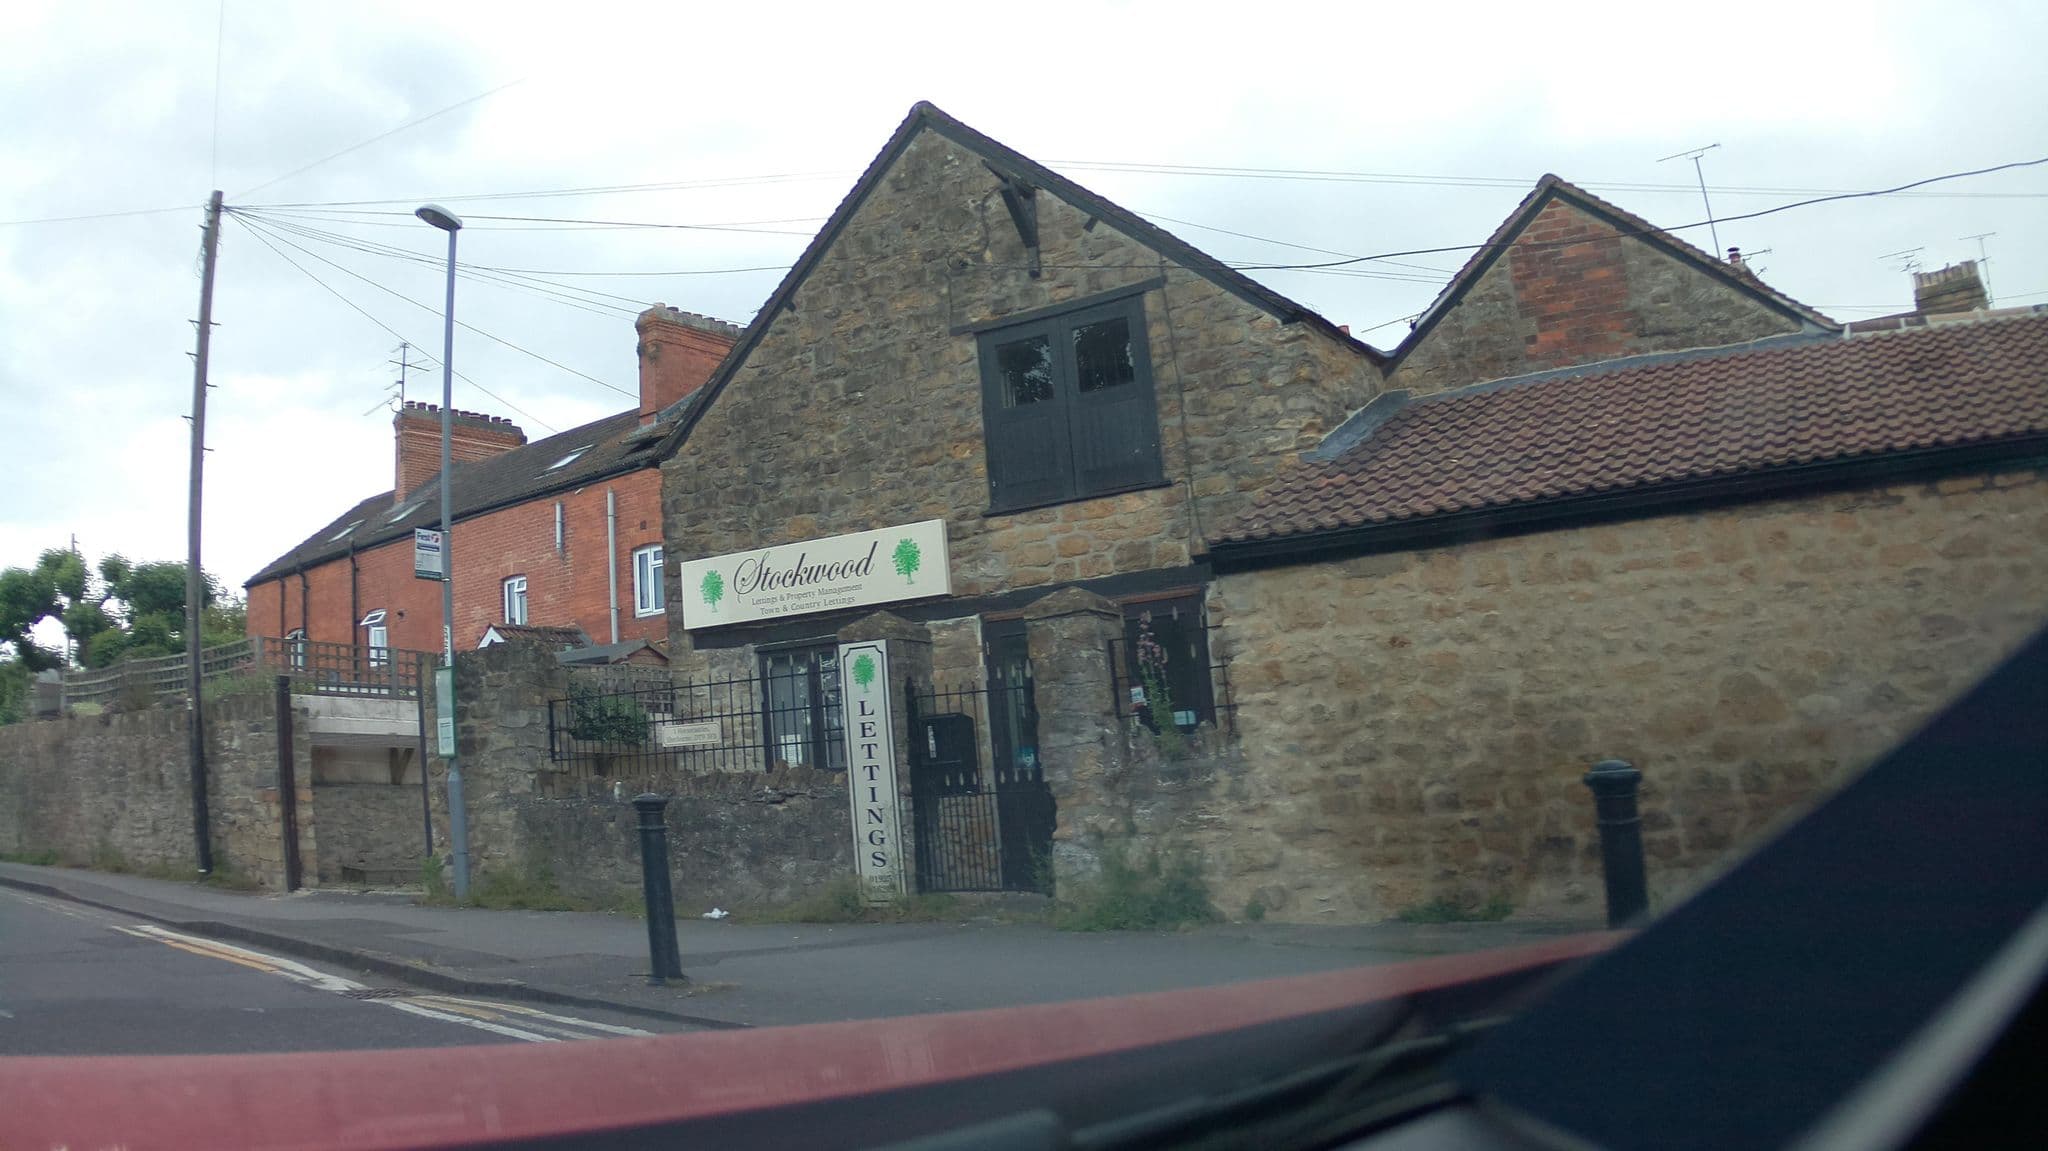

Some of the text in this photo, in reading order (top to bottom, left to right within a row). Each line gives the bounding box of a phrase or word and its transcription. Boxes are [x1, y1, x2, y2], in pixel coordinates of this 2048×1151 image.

[734, 541, 878, 603] Stockwood
[787, 592, 815, 602] Property
[818, 583, 862, 595] Management
[761, 606, 780, 616] Town
[791, 600, 821, 611] Country
[824, 595, 855, 607] Lettings
[858, 700, 886, 868] LETTINGS
